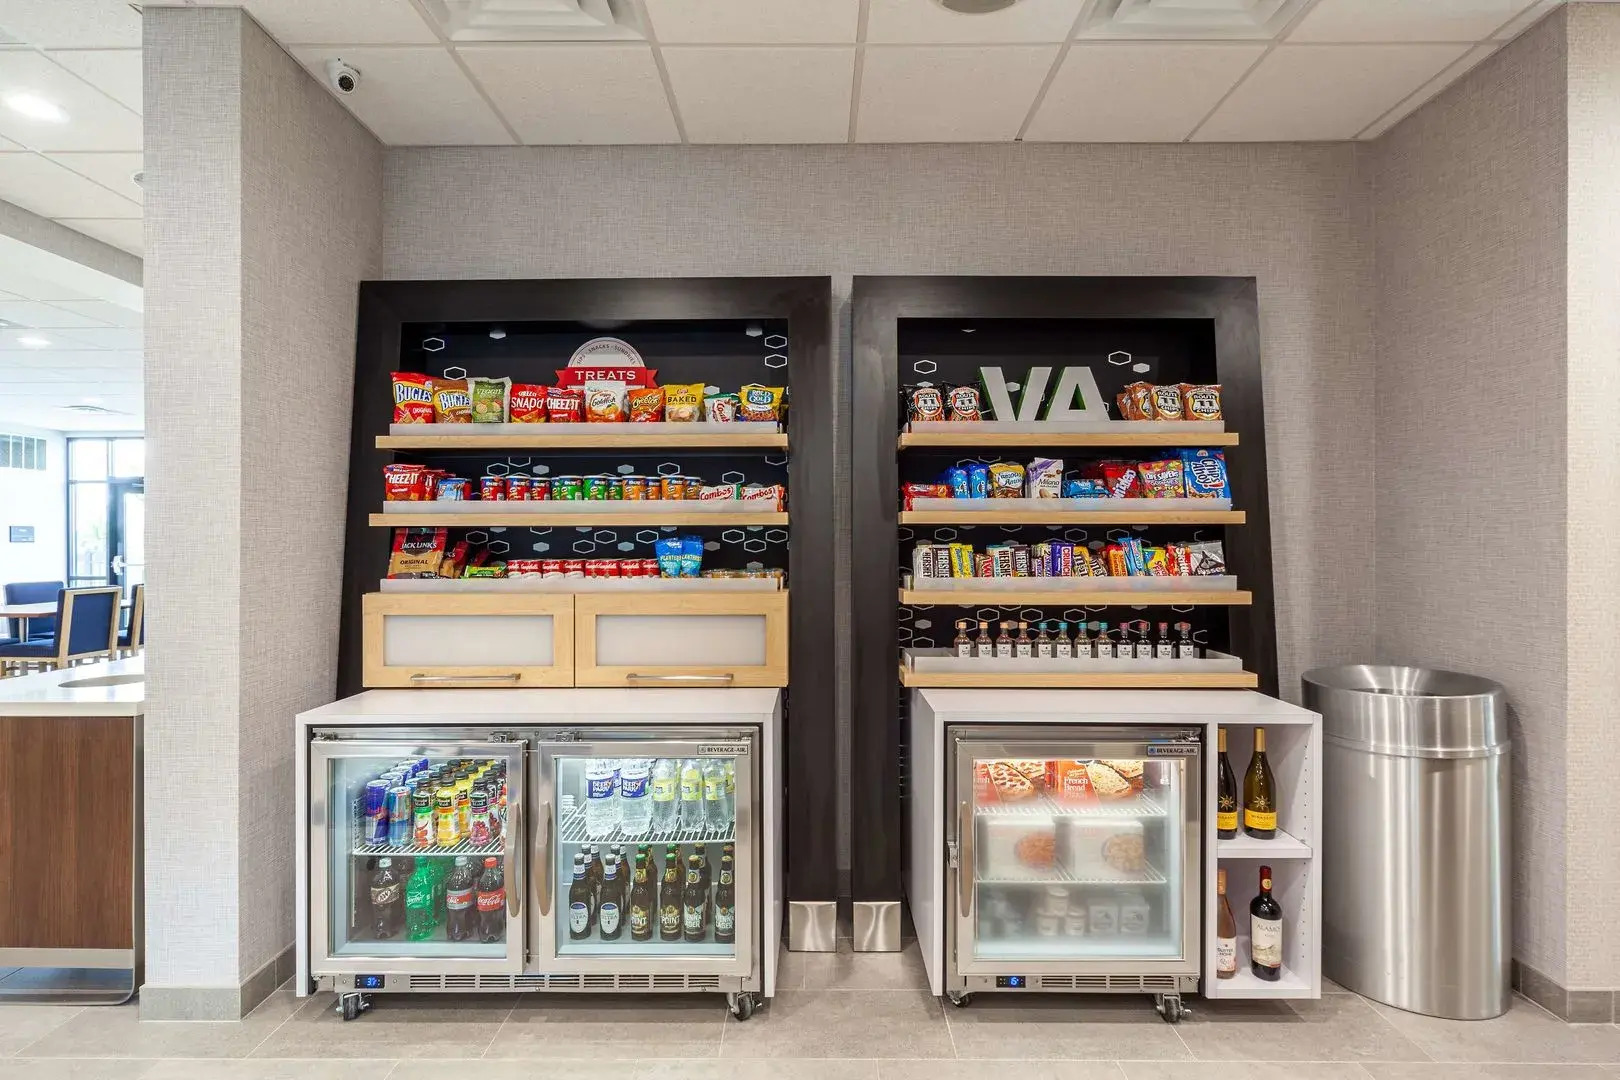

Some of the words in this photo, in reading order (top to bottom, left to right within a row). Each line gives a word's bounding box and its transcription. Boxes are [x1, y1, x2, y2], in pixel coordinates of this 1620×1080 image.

[588, 343, 610, 354] SNACKS
[614, 345, 636, 365] SUNDRIES
[574, 370, 636, 381] TREATS
[395, 383, 433, 404] BUGLES
[667, 395, 697, 403] BAKED
[749, 395, 771, 404] GOLD
[980, 366, 1110, 421] VA
[591, 396, 616, 408] Goldfish
[632, 393, 660, 410] Cheetos
[1037, 478, 1060, 488] Milano
[700, 486, 734, 501] Combos
[400, 558, 429, 566] ORIGINAL
[1062, 547, 1071, 577] CRUNCH
[1063, 776, 1089, 785] French
